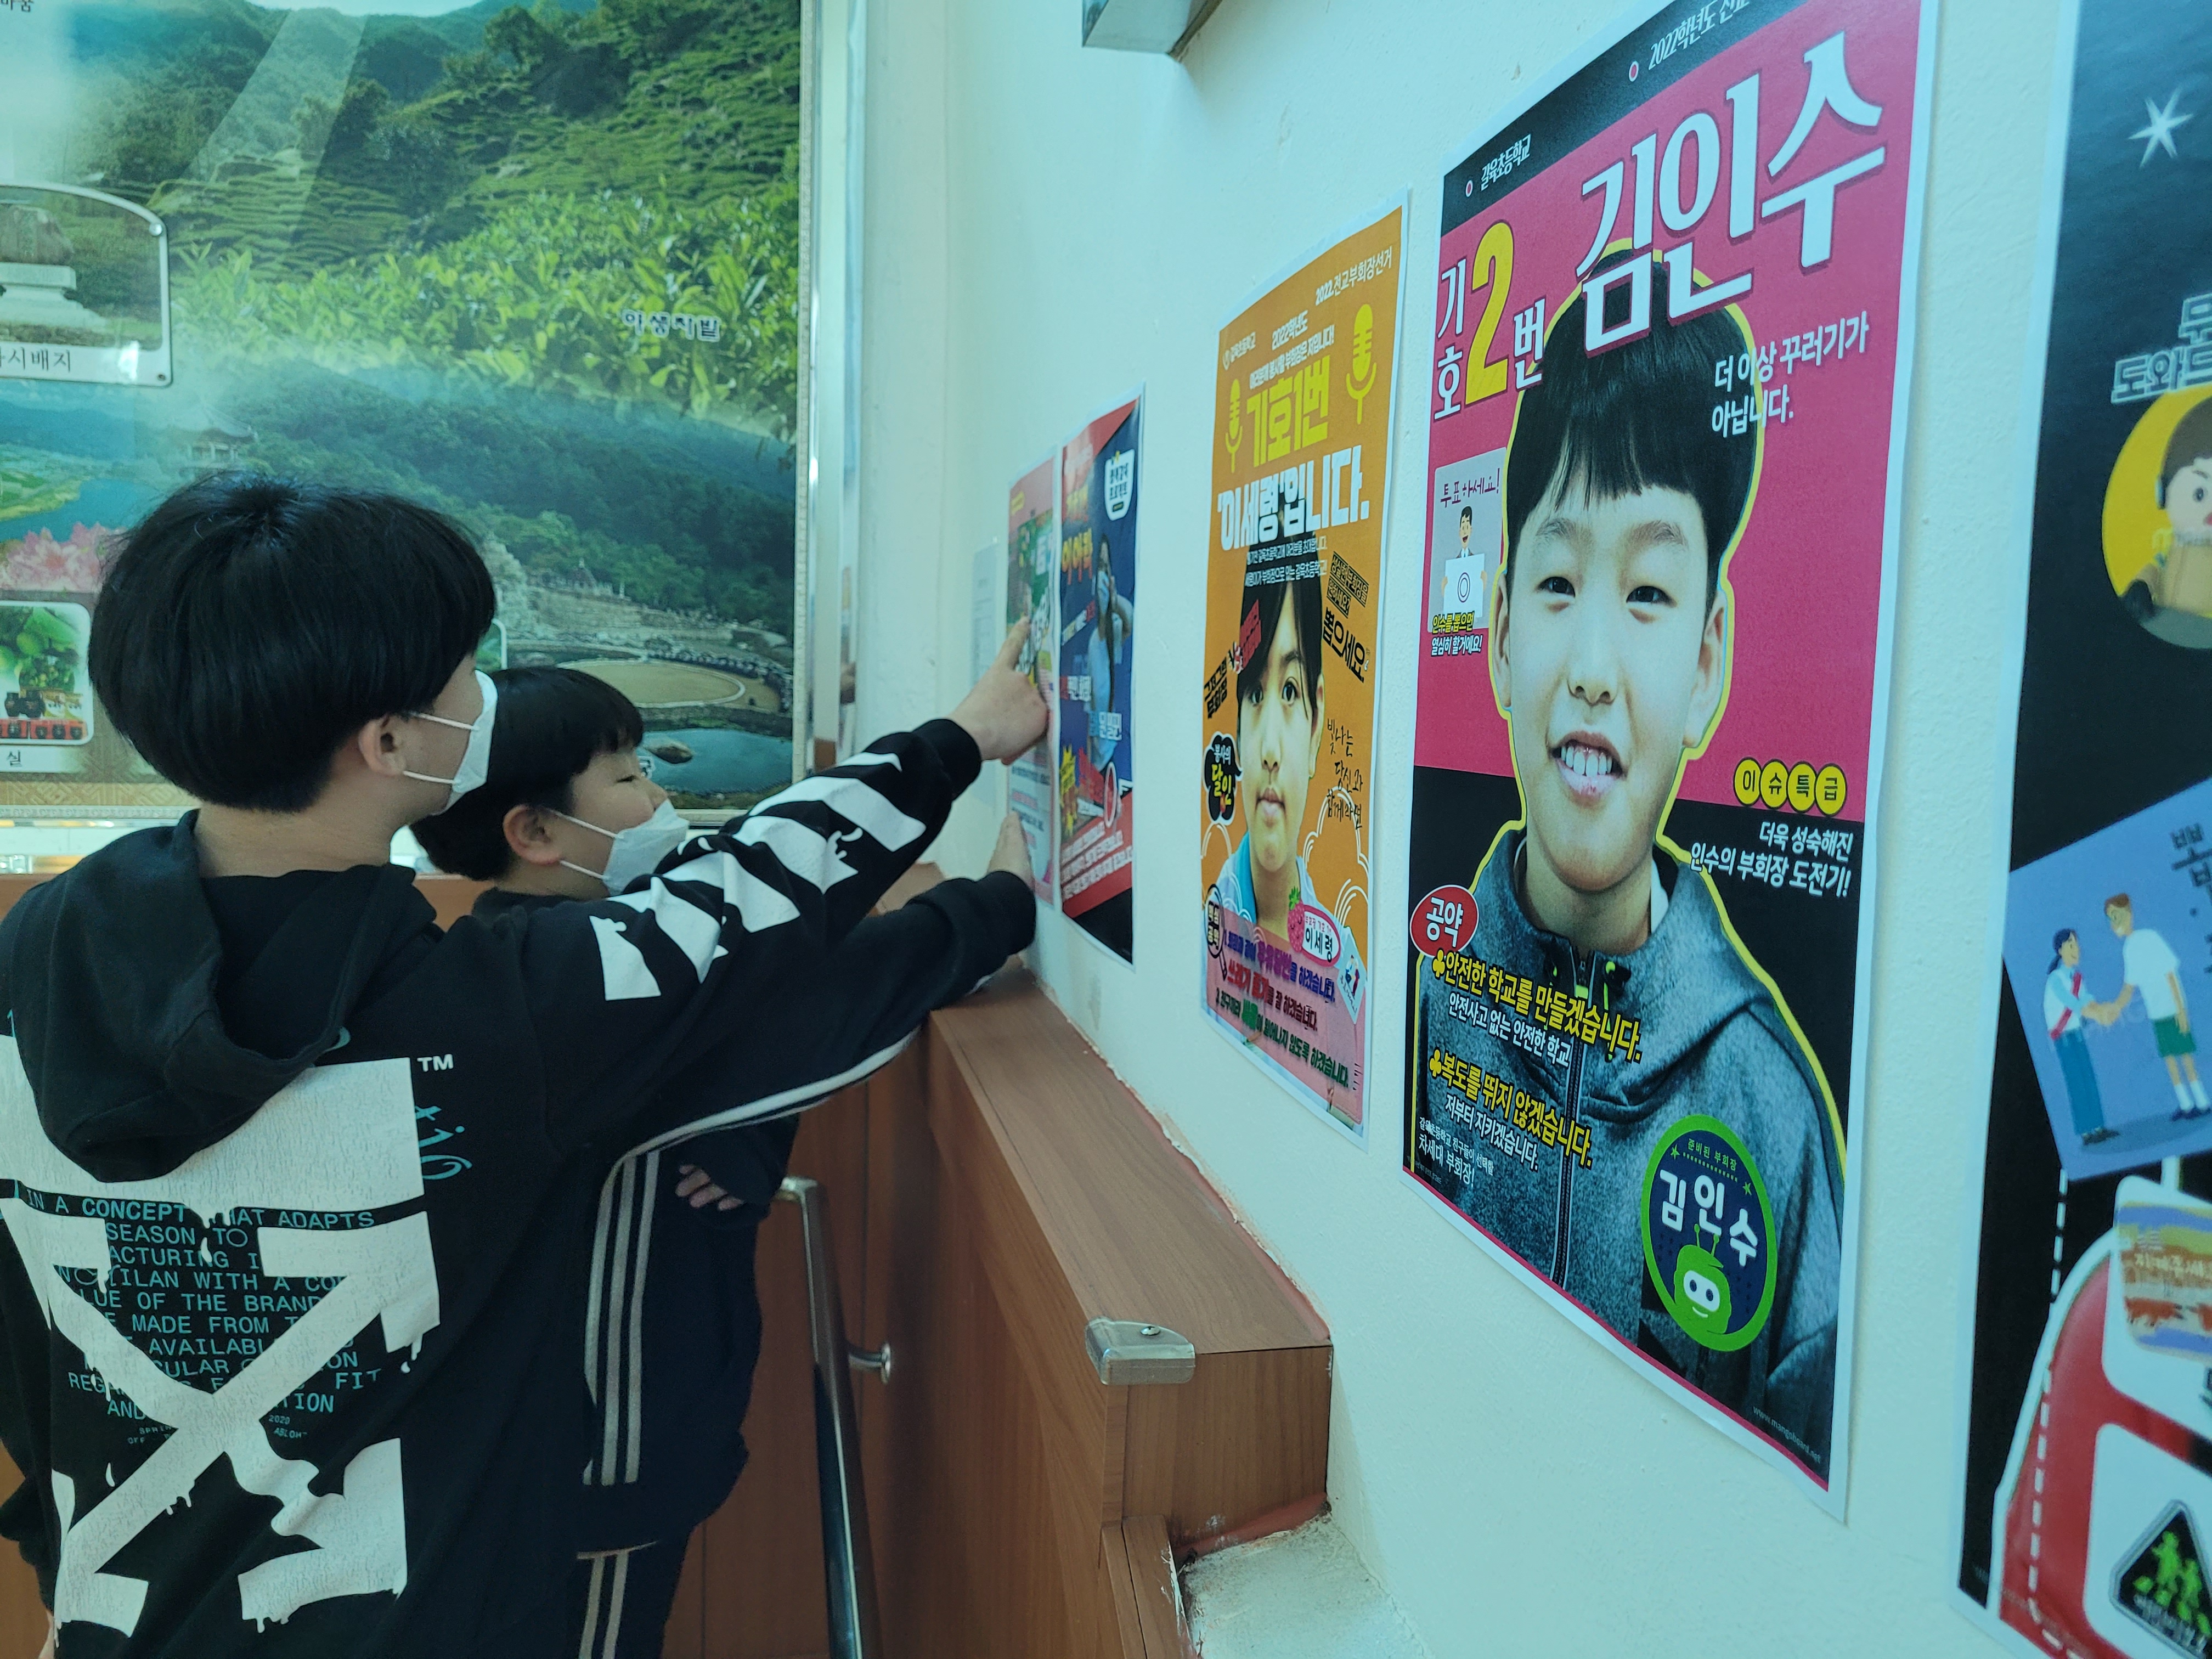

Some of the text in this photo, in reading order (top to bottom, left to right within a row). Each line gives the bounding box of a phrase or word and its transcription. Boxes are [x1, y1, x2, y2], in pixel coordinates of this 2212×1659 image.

[1647, 0, 1718, 70] 2022학년도
[1481, 133, 1531, 191] 갈육초등학교
[1576, 30, 1886, 357] 김인수
[0, 347, 71, 373] 시배지
[1714, 311, 1870, 392] 더 이상 꾸러기가
[1246, 354, 1331, 468] 기호1번
[1712, 384, 1794, 438] 아닙니다.
[1432, 611, 1475, 635] 인수를 뽑으면
[1431, 635, 1452, 656] 열심히
[1327, 718, 1354, 758] 빛나는
[1211, 763, 1232, 806] 달인
[1334, 759, 1363, 793] 당신과
[1742, 769, 1838, 802] 이슈특급
[1759, 821, 1854, 862] 더욱 성숙해진
[1691, 842, 1852, 898] 인수의 부회장 도전기!
[1426, 896, 1464, 947] 공약
[1444, 951, 1641, 1062] 안전한 학교를 만들겠습니다.
[1449, 992, 1572, 1067] 안전사고 없는 안전한 학교
[416, 1053, 454, 1072] TM
[1310, 1047, 1348, 1088] 하겠습니다.
[1441, 1052, 1593, 1167] 복도를 뛰지 않겠습니다.
[1446, 1093, 1475, 1131] 저부터
[1475, 1110, 1538, 1171] 지키겠습니다.
[1418, 1133, 1444, 1167] 차세대
[1445, 1149, 1475, 1188] 부회장!
[1452, 1137, 1475, 1164] 친구들이
[1476, 1153, 1494, 1177] 선택할
[1688, 1138, 1737, 1172] 준비된 부회장
[26, 1188, 44, 1210] IN
[55, 1195, 70, 1214] A
[82, 1197, 185, 1223] CONCEPT
[278, 1210, 375, 1230] ADAPTS
[1660, 1169, 1759, 1267] 김인수
[105, 1222, 248, 1248] SEASON TO
[110, 1245, 229, 1269] ACTURING
[137, 1291, 165, 1311] OF
[180, 1293, 228, 1312] THE
[193, 1271, 258, 1290] WITH
[273, 1276, 291, 1291] A
[131, 1313, 192, 1334] MADE
[208, 1316, 269, 1334] FROM
[107, 1399, 146, 1420] AND
